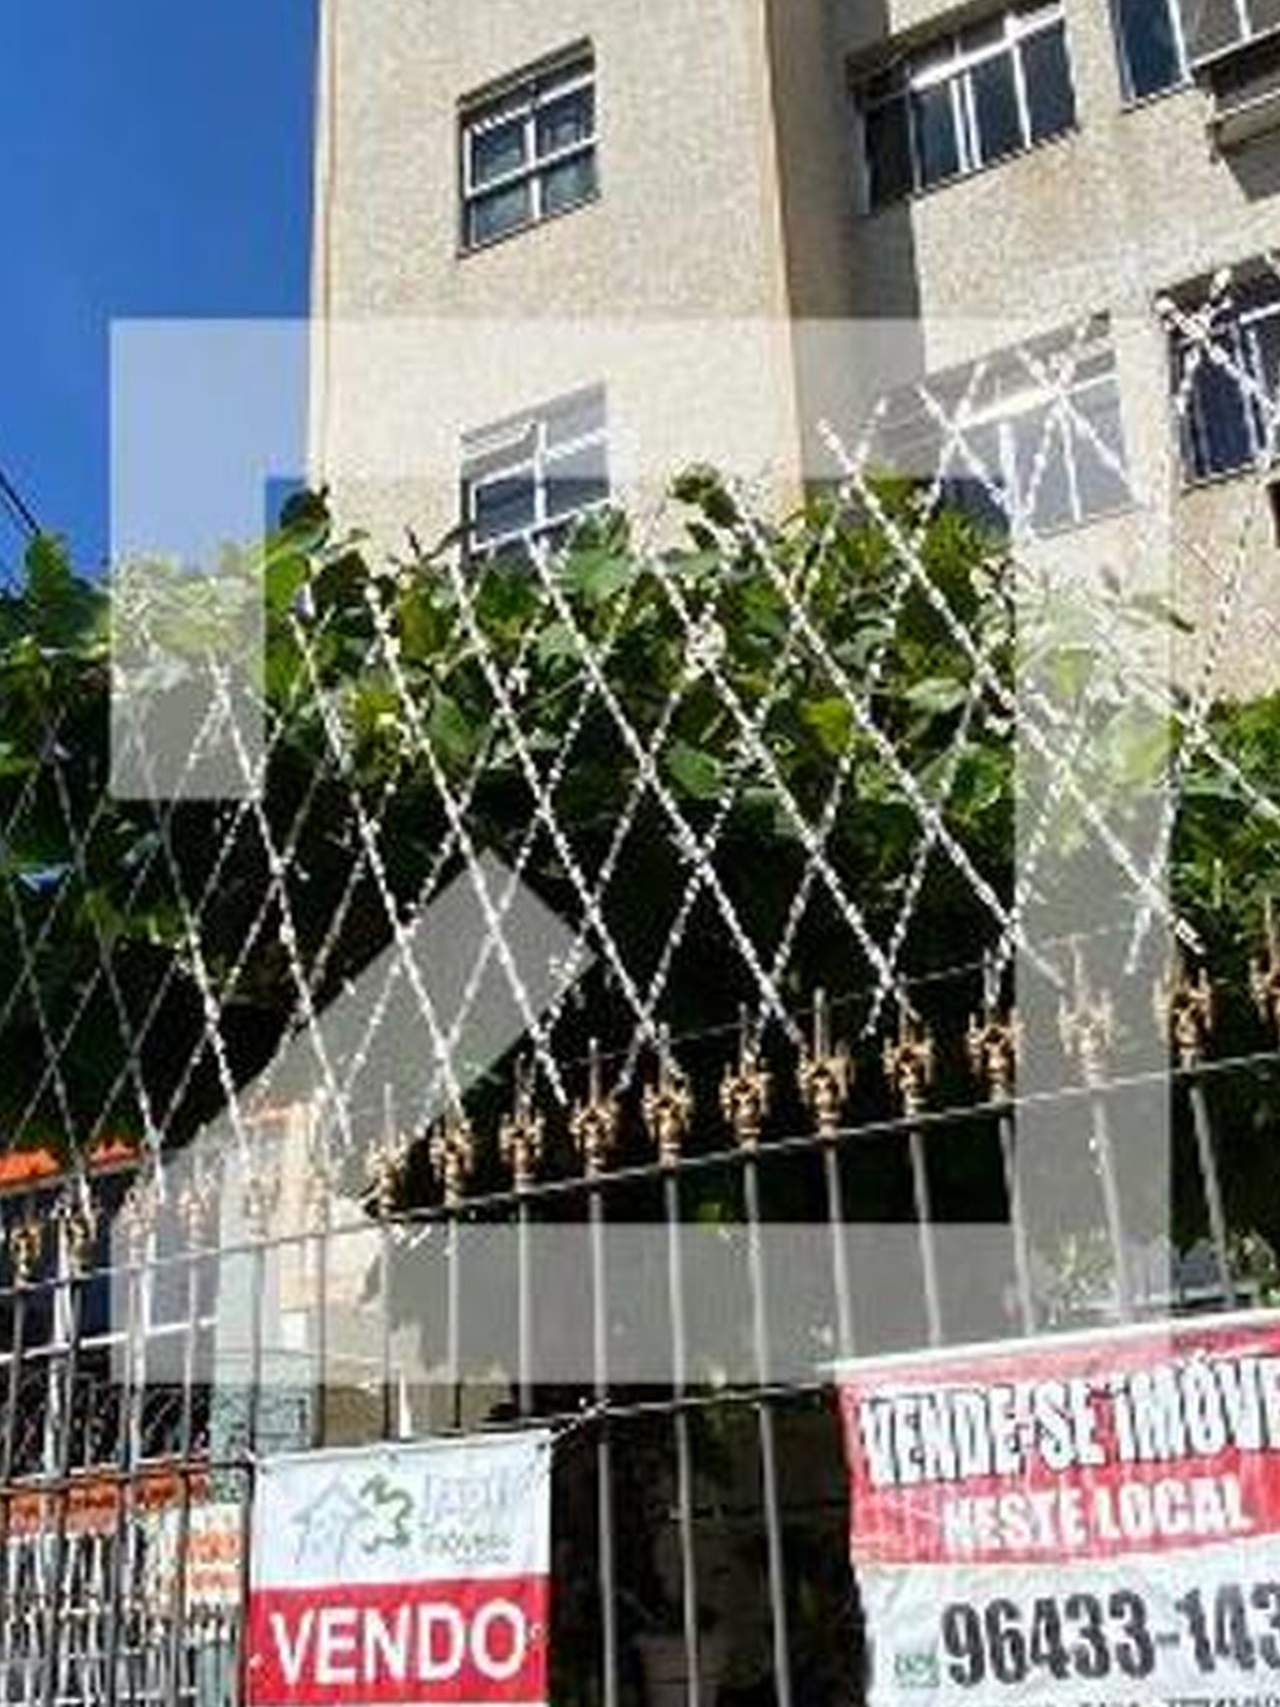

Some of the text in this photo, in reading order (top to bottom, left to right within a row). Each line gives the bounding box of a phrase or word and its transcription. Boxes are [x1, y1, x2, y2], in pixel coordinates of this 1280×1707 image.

[942, 1475, 1253, 1553] NESTE LOCAL
[269, 1596, 528, 1685] VENDO
